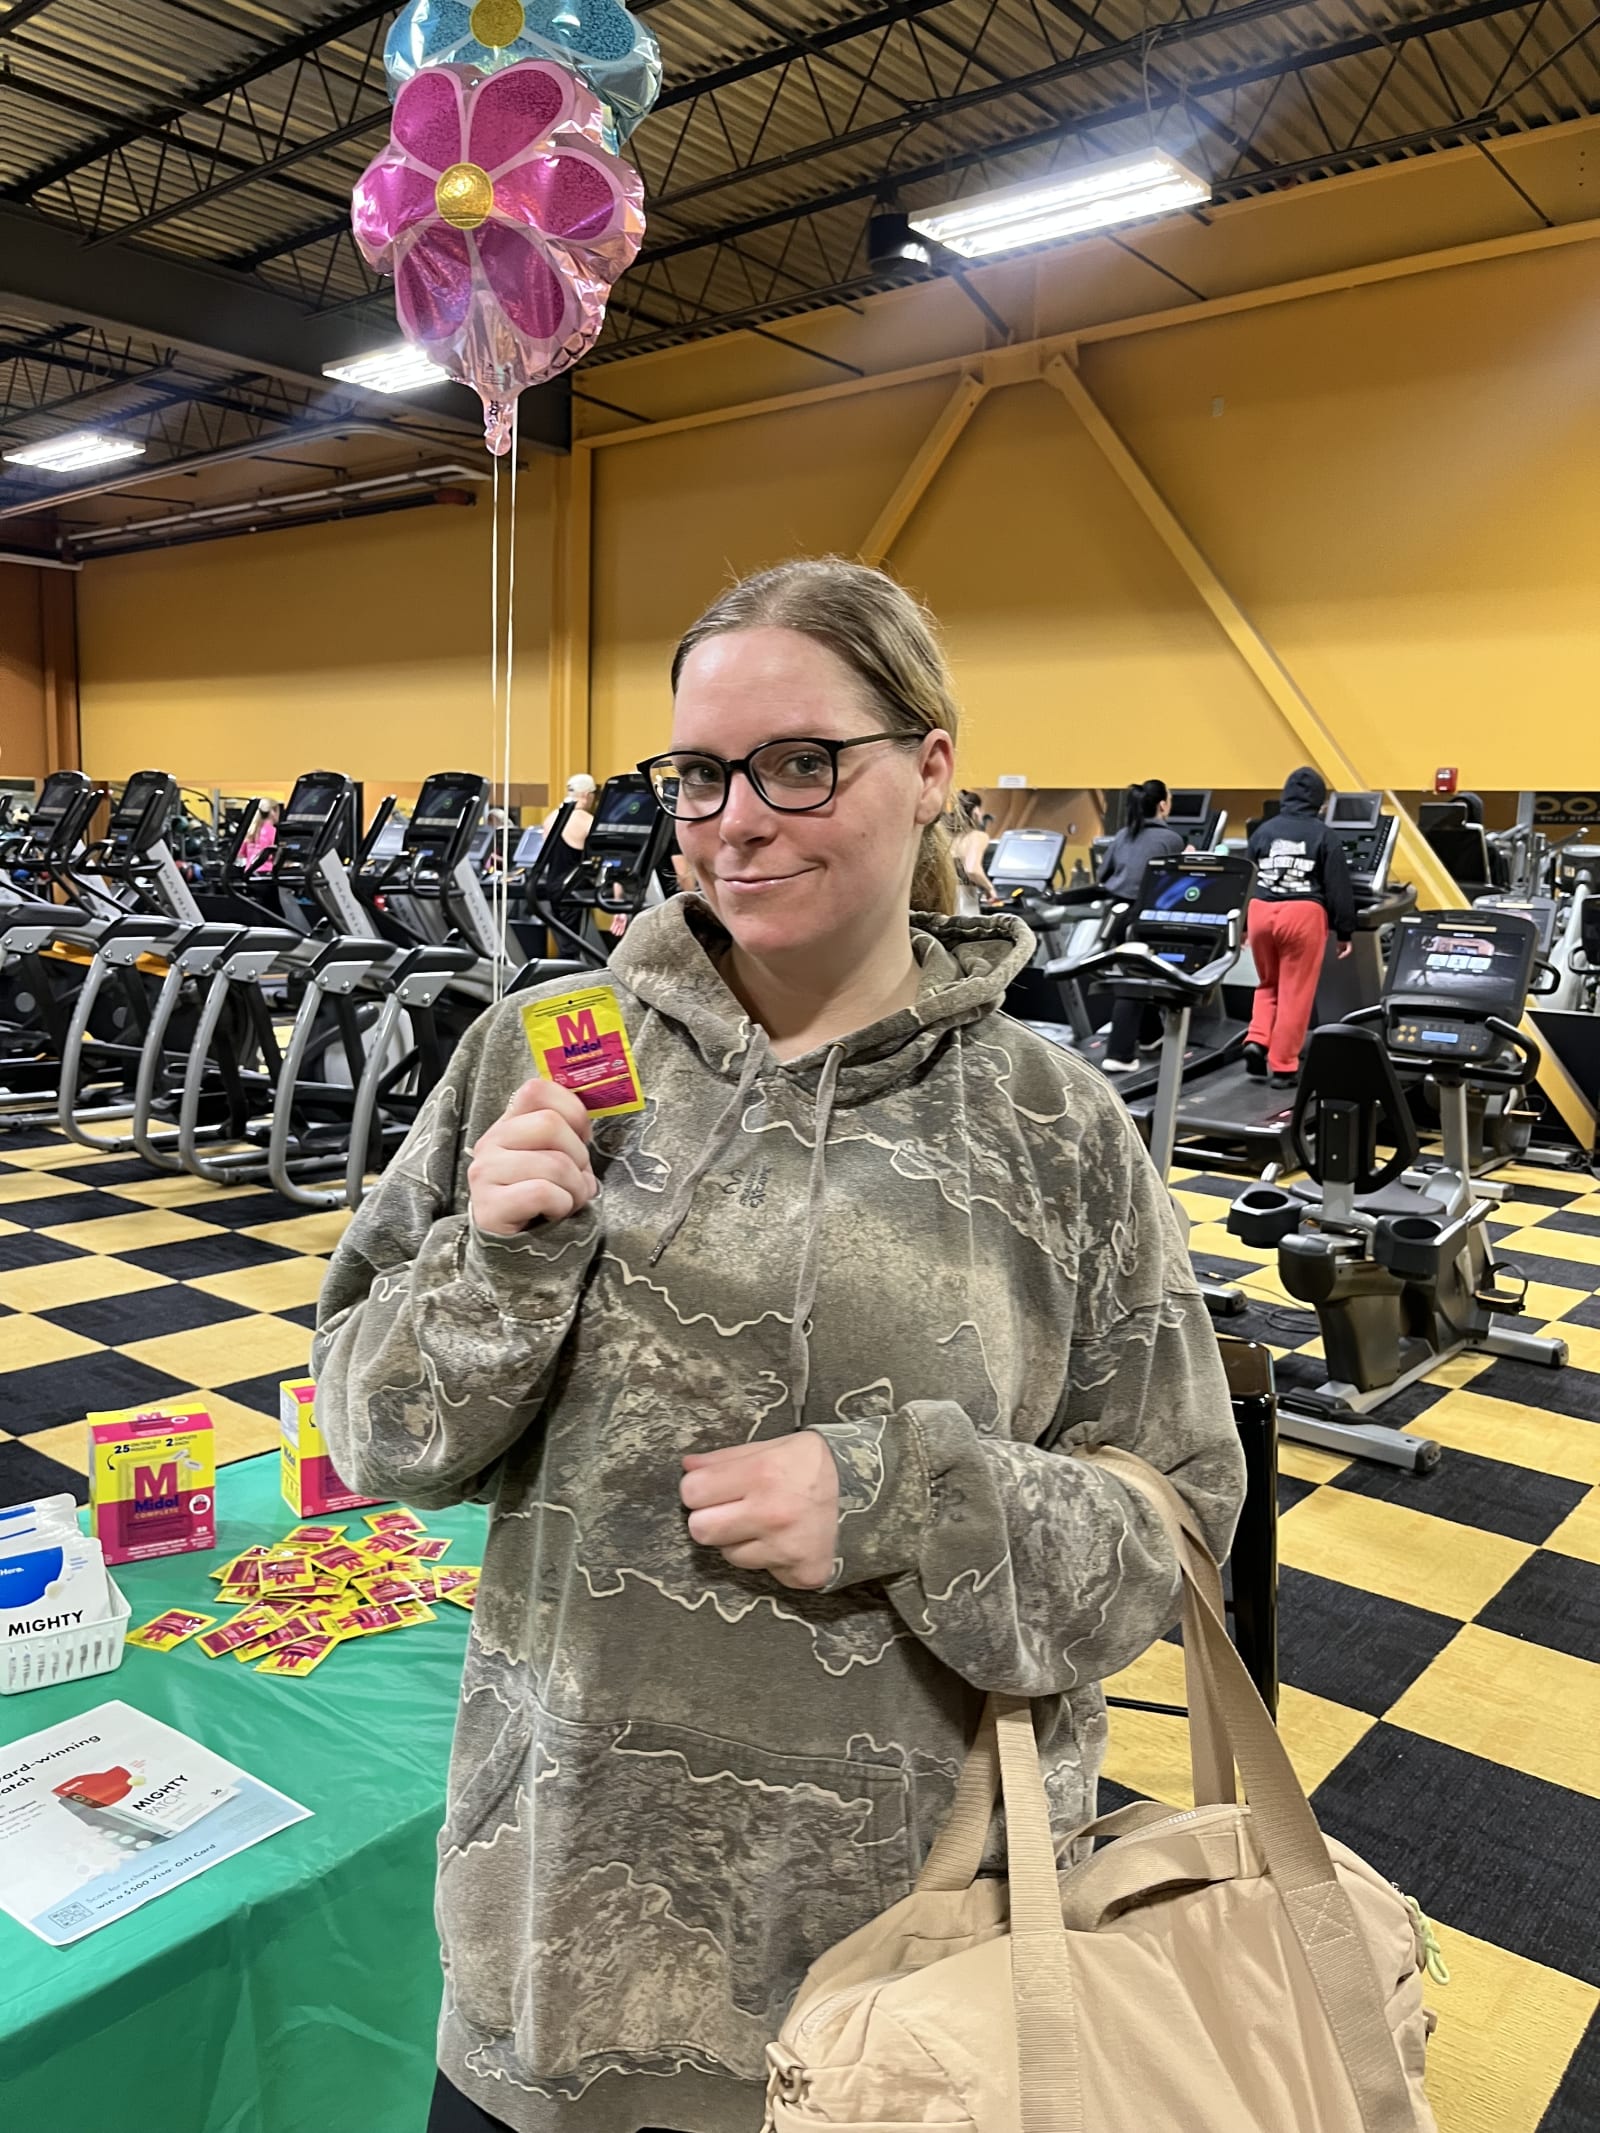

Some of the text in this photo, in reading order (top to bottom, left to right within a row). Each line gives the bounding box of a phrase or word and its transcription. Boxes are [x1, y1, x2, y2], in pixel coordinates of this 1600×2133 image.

[556, 1009, 599, 1046] M
[563, 1039, 602, 1058] Midol
[114, 1444, 130, 1454] 25
[166, 1438, 173, 1447] 2
[134, 1462, 178, 1500] M
[135, 1495, 179, 1512] Midol
[8, 1610, 83, 1637] MIGHTY
[0, 1735, 102, 1783] ard-winning
[0, 1776, 36, 1796] atch
[132, 1774, 189, 1811] MIGHTY
[144, 1789, 188, 1816] PATCH
[96, 1899, 115, 1909] win
[124, 1880, 150, 1896] $500
[193, 1843, 216, 1858] Card
